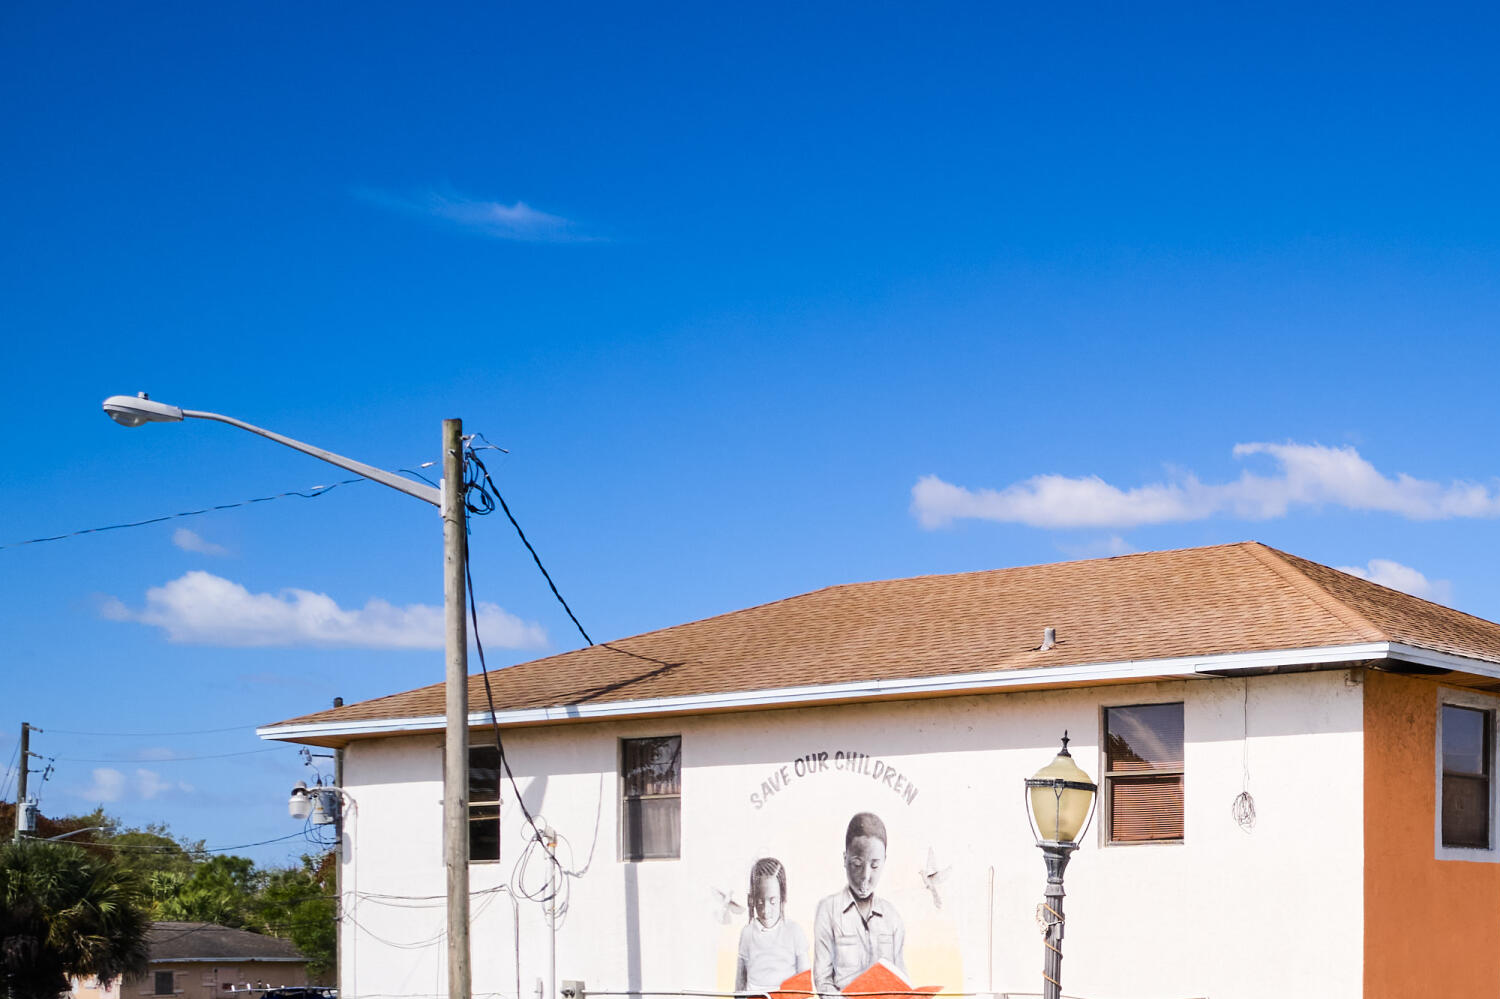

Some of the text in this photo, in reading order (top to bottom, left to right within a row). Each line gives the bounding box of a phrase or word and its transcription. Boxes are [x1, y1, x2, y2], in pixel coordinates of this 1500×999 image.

[750, 750, 919, 810] SAVE OUR CHILDREN
